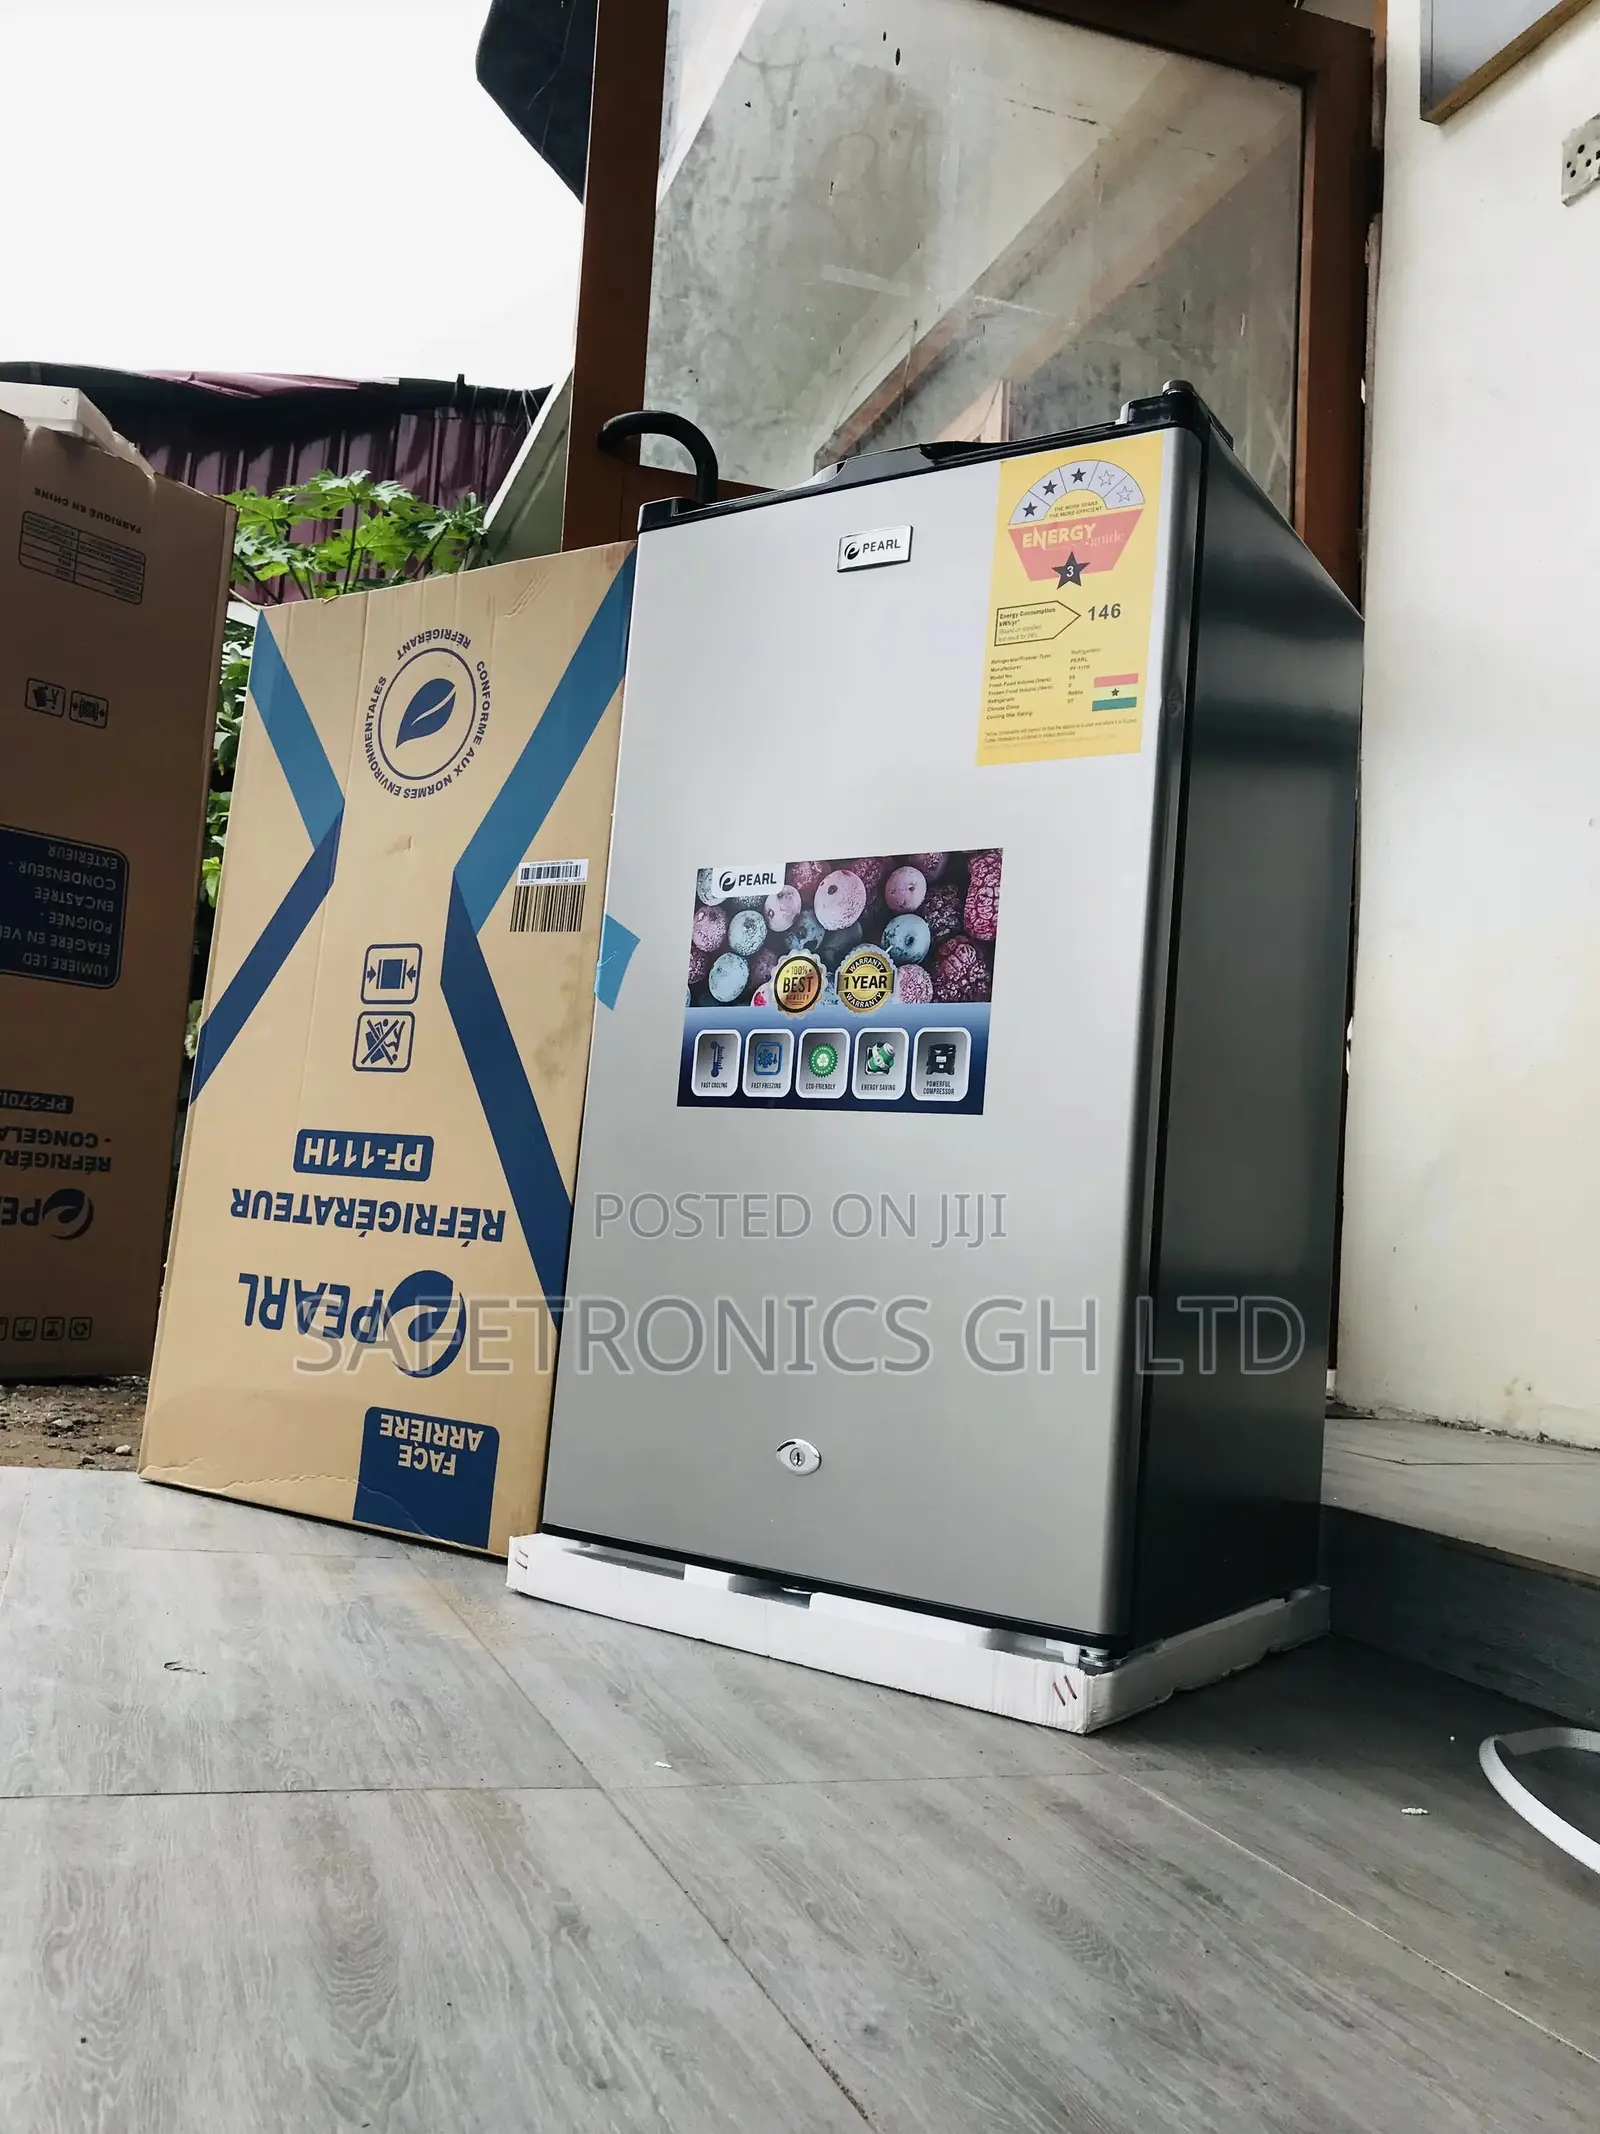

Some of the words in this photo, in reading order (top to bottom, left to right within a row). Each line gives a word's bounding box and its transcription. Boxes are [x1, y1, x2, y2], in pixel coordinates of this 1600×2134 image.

[33, 487, 69, 507] CHINE
[72, 501, 87, 513] EN
[862, 539, 902, 554] PEARL
[1022, 523, 1097, 551] ENERGY
[1066, 565, 1075, 578] 3
[1019, 607, 1056, 617] Consumption
[1088, 603, 1122, 621] 146
[473, 661, 491, 745] CONFORME
[452, 747, 475, 777] AUX
[403, 774, 453, 799] NORMES
[18, 861, 117, 891] CONDENSEUR
[738, 872, 777, 887] PEARL
[34, 886, 115, 912] ENCASTRÉE
[49, 911, 113, 935] POIGNÉE
[27, 930, 46, 944] EN
[22, 952, 47, 967] LED
[848, 956, 885, 972] WARRANTY
[782, 976, 814, 994] BEST
[846, 992, 882, 1008] WARRANTY
[700, 1081, 711, 1089] FAST
[925, 1080, 951, 1088] POWERFUL
[302, 1137, 424, 1173] PF-111H
[0, 1197, 42, 1227] PE
[230, 1188, 507, 1248] RÉFRIGÉRATEUR
[238, 1272, 385, 1345] PEARL
[379, 1413, 485, 1452] ARRIÈRE
[398, 1444, 457, 1476] FACE
